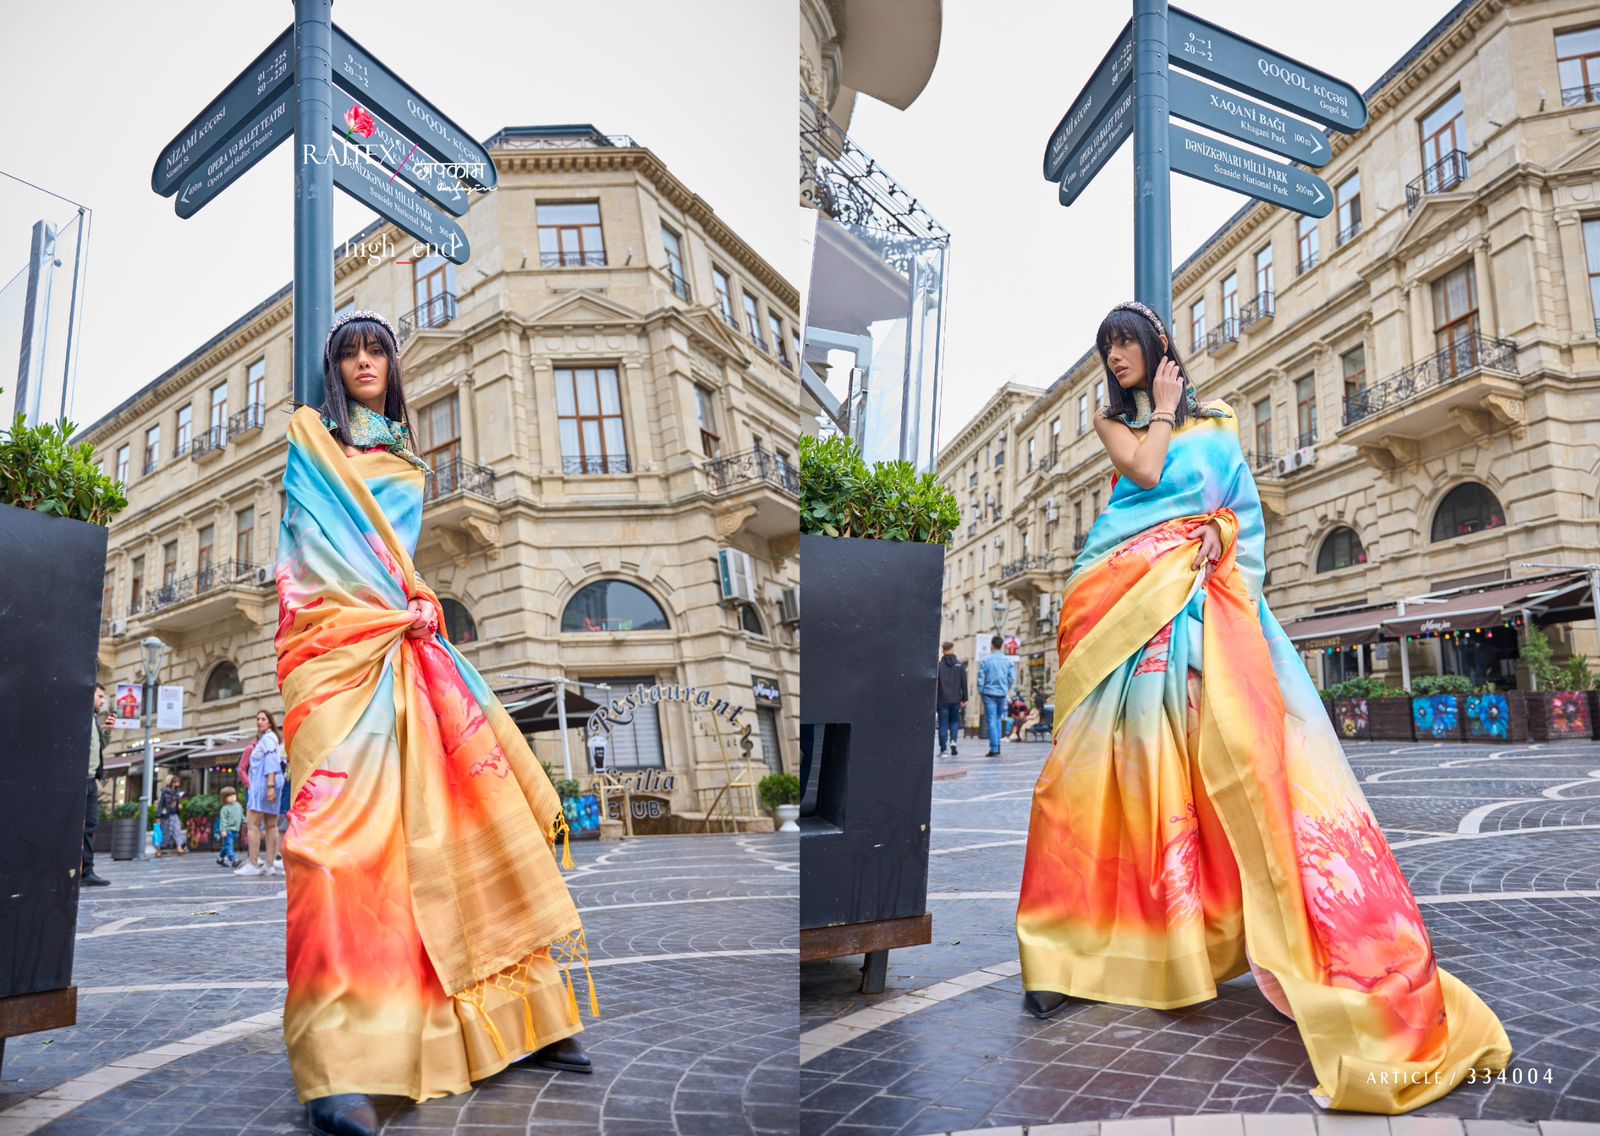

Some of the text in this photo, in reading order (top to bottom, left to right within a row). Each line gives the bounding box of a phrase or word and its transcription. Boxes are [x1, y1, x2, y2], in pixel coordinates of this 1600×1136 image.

[1184, 42, 1213, 62] 20 2
[1189, 32, 1212, 50] 9 1
[257, 50, 287, 83] 91 225
[257, 62, 287, 96] 80 220
[344, 62, 369, 88] 20 2
[348, 54, 368, 76] 9 1
[1257, 58, 1310, 91] QOQOL
[407, 99, 450, 142] QOQOL
[1210, 94, 1286, 133] XAQANİ BAĞI
[1320, 100, 1339, 115] Gogol
[166, 129, 197, 170] NİZAMİ
[207, 153, 228, 176] OPERA
[238, 124, 259, 150] BALET
[260, 102, 286, 131] TEATRI
[1271, 131, 1287, 145] Park
[1294, 133, 1312, 147] 100m
[207, 171, 224, 188] Opera
[223, 160, 234, 175] and
[1214, 163, 1314, 198] Seaside National Park 500m
[1267, 166, 1288, 184] PARK
[369, 186, 393, 208] Seaside
[394, 203, 419, 225] National
[420, 222, 433, 235] Park
[415, 203, 433, 223] PARK
[588, 684, 743, 735] Restaurant
[607, 801, 661, 819] CUB
